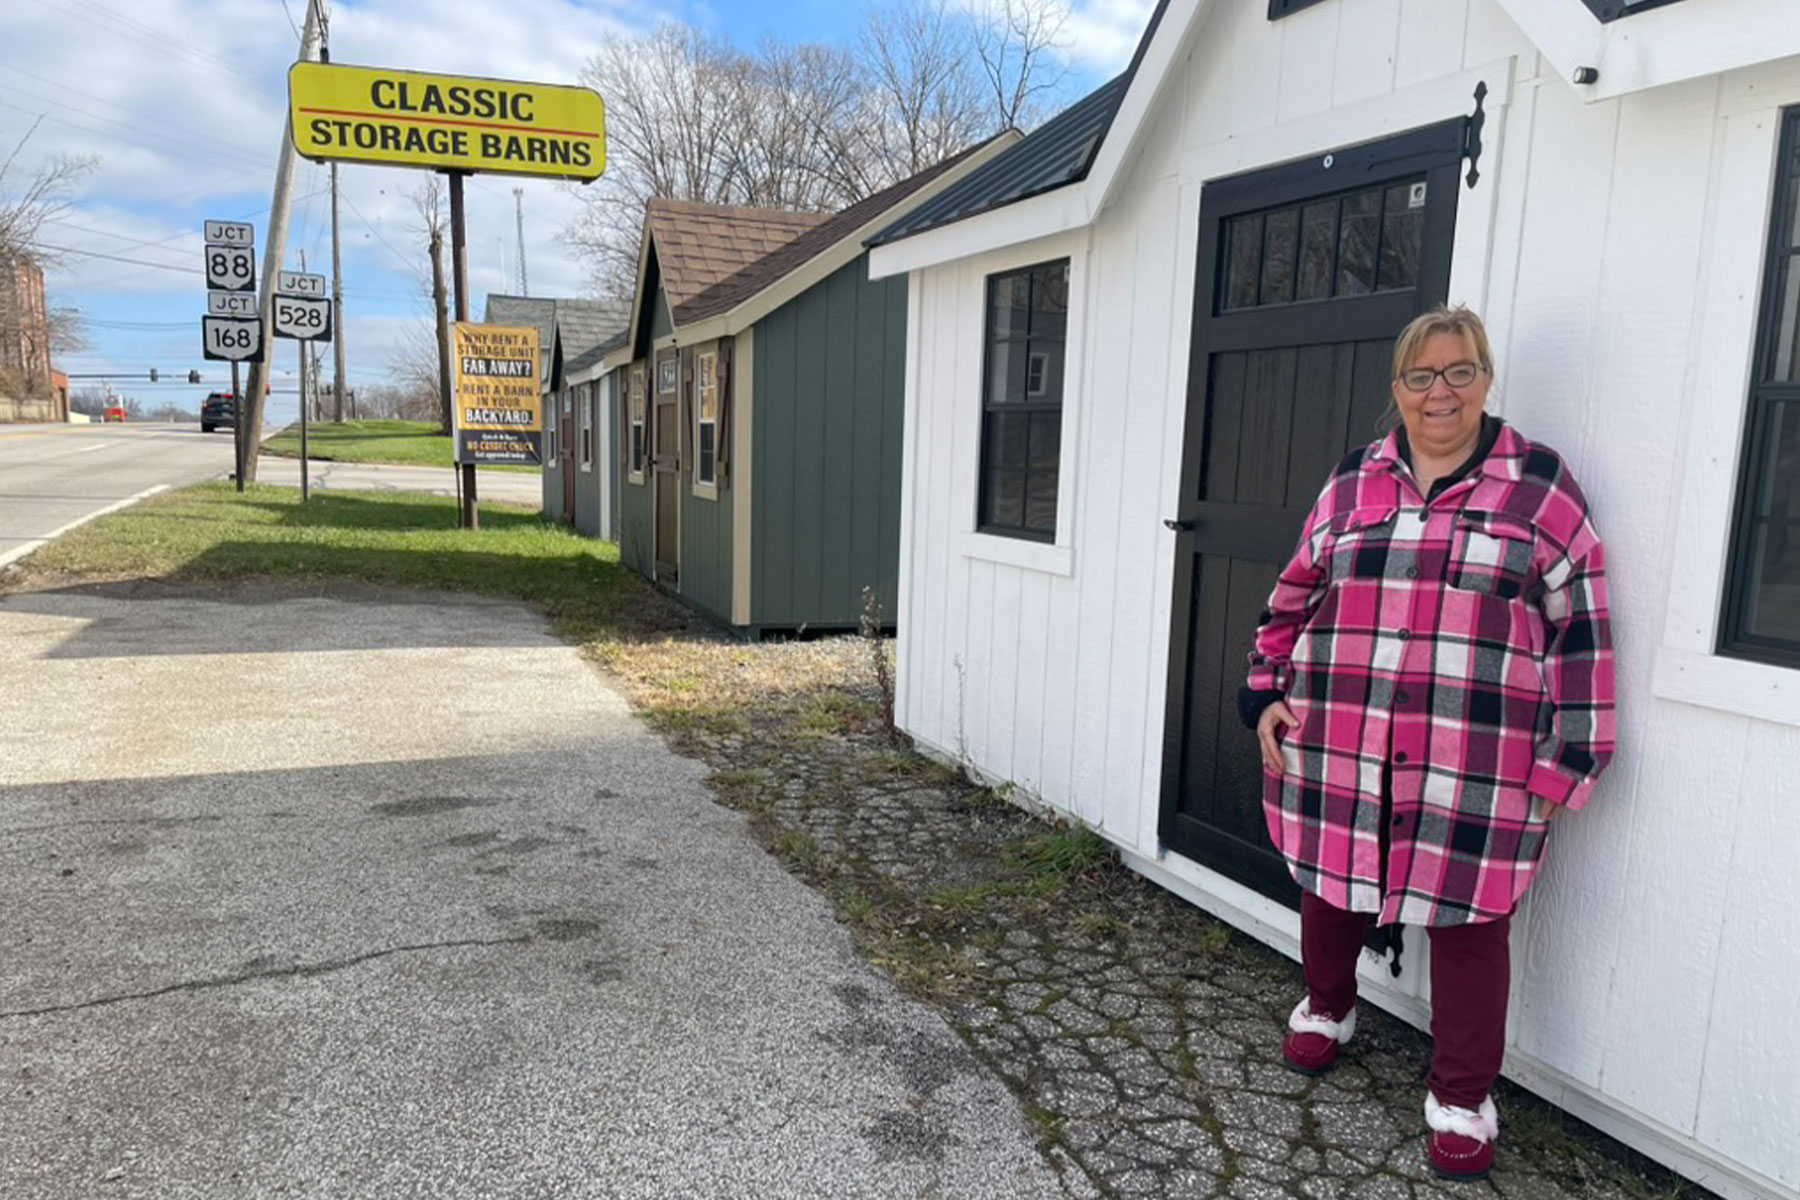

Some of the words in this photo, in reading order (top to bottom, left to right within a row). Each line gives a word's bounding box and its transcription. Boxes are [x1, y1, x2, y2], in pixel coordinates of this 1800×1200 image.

[370, 79, 534, 122] CLASSIC
[310, 118, 470, 156] STORAGE
[480, 132, 592, 167] BARNS
[212, 226, 246, 240] JCT
[211, 253, 250, 278] 88
[285, 277, 319, 291] JCT
[216, 297, 250, 311] JCT
[279, 305, 322, 328] 528
[214, 327, 252, 349] 168
[463, 332, 489, 343] WHY
[491, 334, 518, 345] RENT
[521, 335, 529, 346] A
[457, 344, 506, 357] STORAGE
[508, 347, 535, 359] UNIT
[463, 358, 487, 374] FAR
[489, 360, 531, 377] AWAY?
[463, 383, 490, 395] RENT
[493, 385, 501, 396] A
[504, 386, 533, 397] BARN
[477, 397, 489, 407] IN
[491, 397, 521, 408] YOUR
